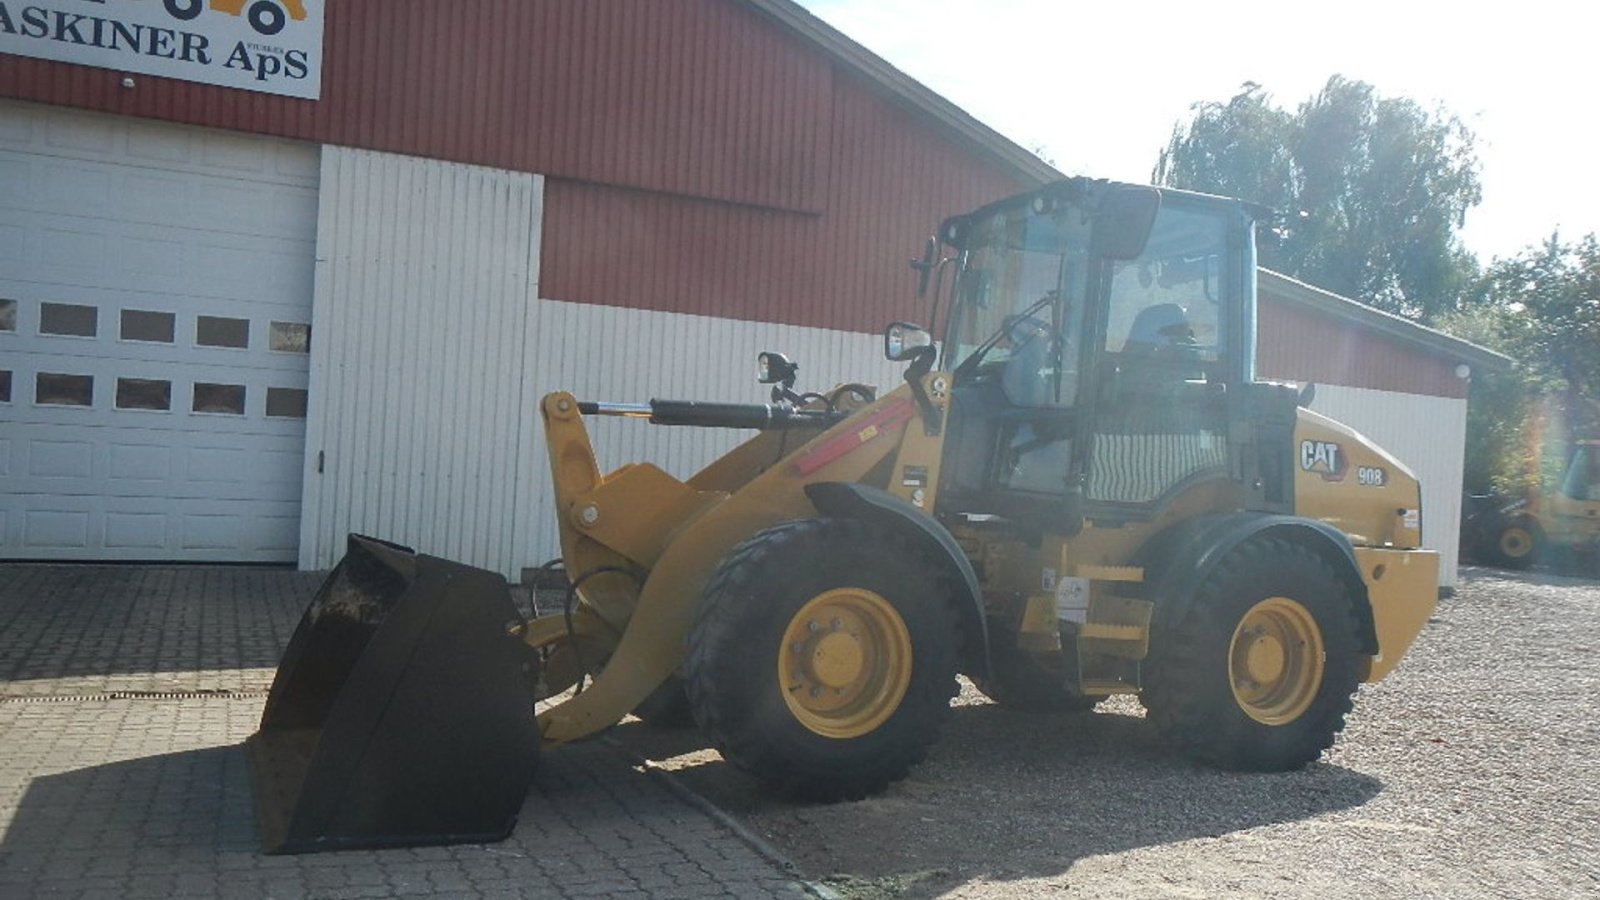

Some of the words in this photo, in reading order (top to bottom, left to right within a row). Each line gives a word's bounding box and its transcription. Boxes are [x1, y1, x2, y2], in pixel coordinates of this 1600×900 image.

[222, 40, 308, 81] ApS
[1301, 440, 1338, 472] CAT
[1358, 466, 1383, 486] 908
